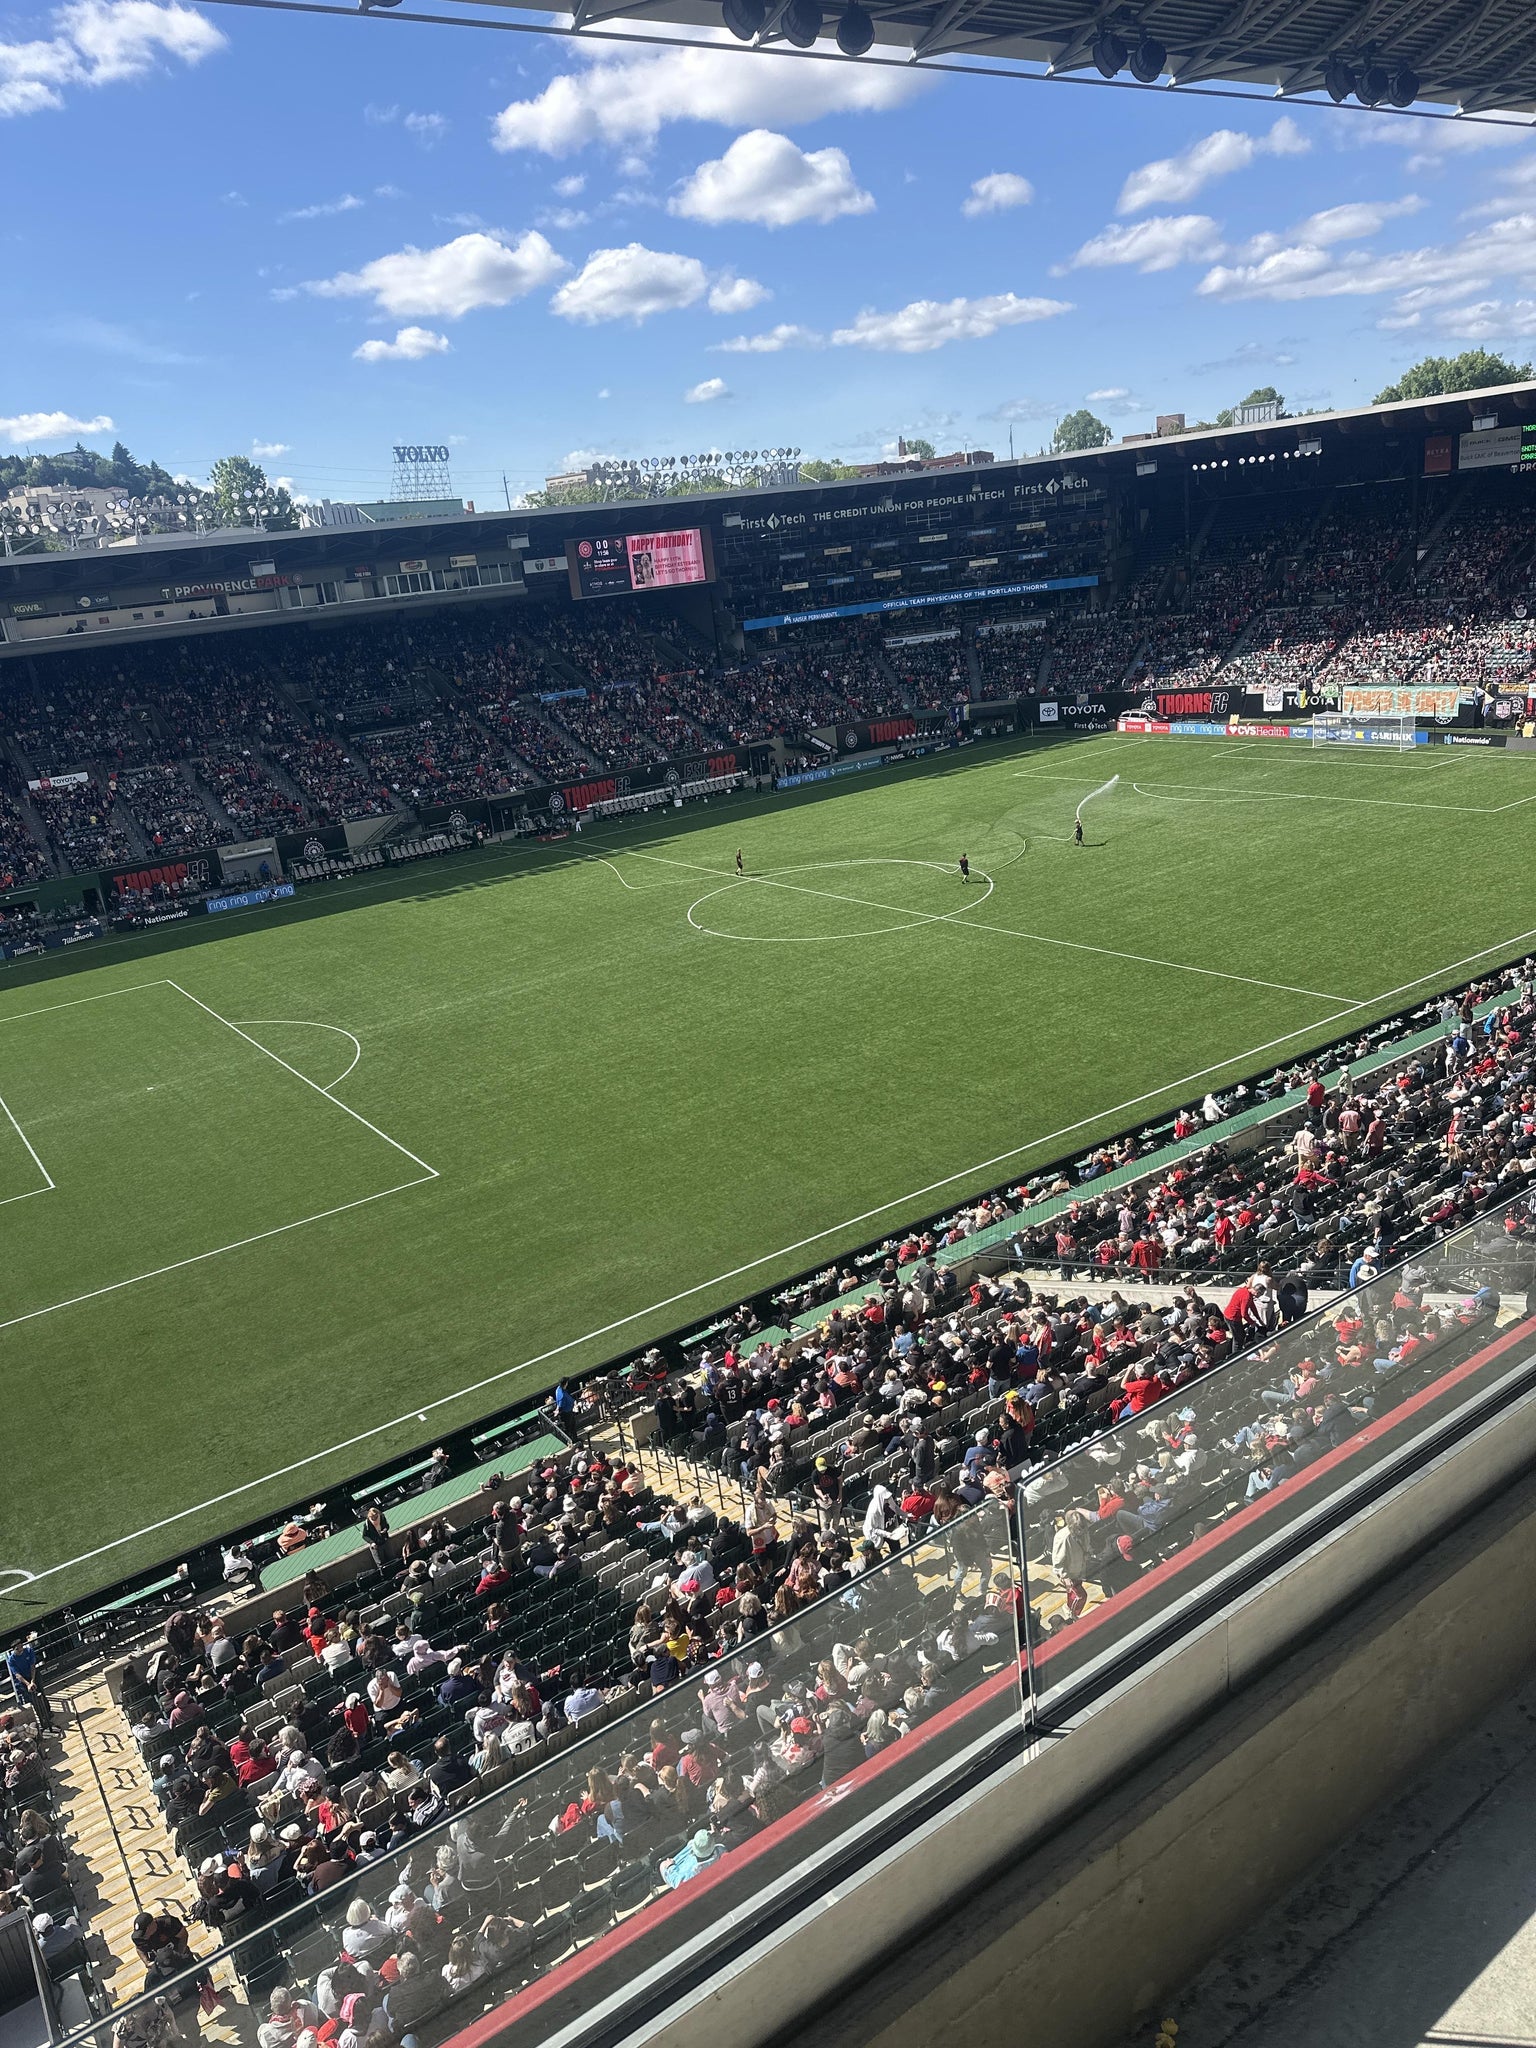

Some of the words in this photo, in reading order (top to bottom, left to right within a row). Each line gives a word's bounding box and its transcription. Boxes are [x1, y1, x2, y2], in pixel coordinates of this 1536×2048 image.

[393, 446, 449, 462] VOLVO
[1014, 483, 1043, 496] First
[1061, 478, 1089, 490] Tech
[813, 511, 831, 521] THE
[833, 507, 868, 519] CREDIT
[871, 502, 902, 514] UNION
[904, 500, 924, 510] FOR
[927, 495, 964, 507] PEOPLE
[966, 494, 976, 502] IN
[980, 490, 1005, 500] TECH
[740, 517, 765, 530] First
[780, 513, 806, 525] Tech
[595, 540, 602, 550] 0
[602, 539, 608, 549] 0
[631, 537, 654, 551] HAPPY
[655, 533, 692, 550] BIRTHDAY!
[174, 579, 257, 597] PROVIDENCE
[256, 575, 289, 588] PARK
[927, 594, 963, 603] PHYSICIANS
[987, 586, 1022, 595] PORTLAND
[1022, 583, 1048, 591] THORNS
[1061, 704, 1106, 715] TOYOTA
[1157, 692, 1212, 714] THORNS
[1210, 691, 1229, 714] FC
[868, 718, 916, 744] THORNS
[1183, 725, 1195, 733] ring
[1238, 725, 1256, 735] CVS
[1453, 736, 1490, 745] Nationwide
[683, 760, 708, 780] EST
[708, 753, 737, 778] 2012
[53, 776, 78, 785] TOYOTA
[789, 776, 801, 784] ring
[802, 772, 814, 780] ring
[815, 769, 827, 778] ring
[561, 778, 616, 811] THORNS
[615, 775, 631, 800] FC
[113, 863, 188, 894] THORNS
[187, 858, 210, 882] FC
[208, 900, 228, 910] ring
[230, 895, 249, 906] ring
[144, 911, 188, 925] Nationwide
[61, 930, 95, 945] Tillamook
[727, 1389, 736, 1400] 13
